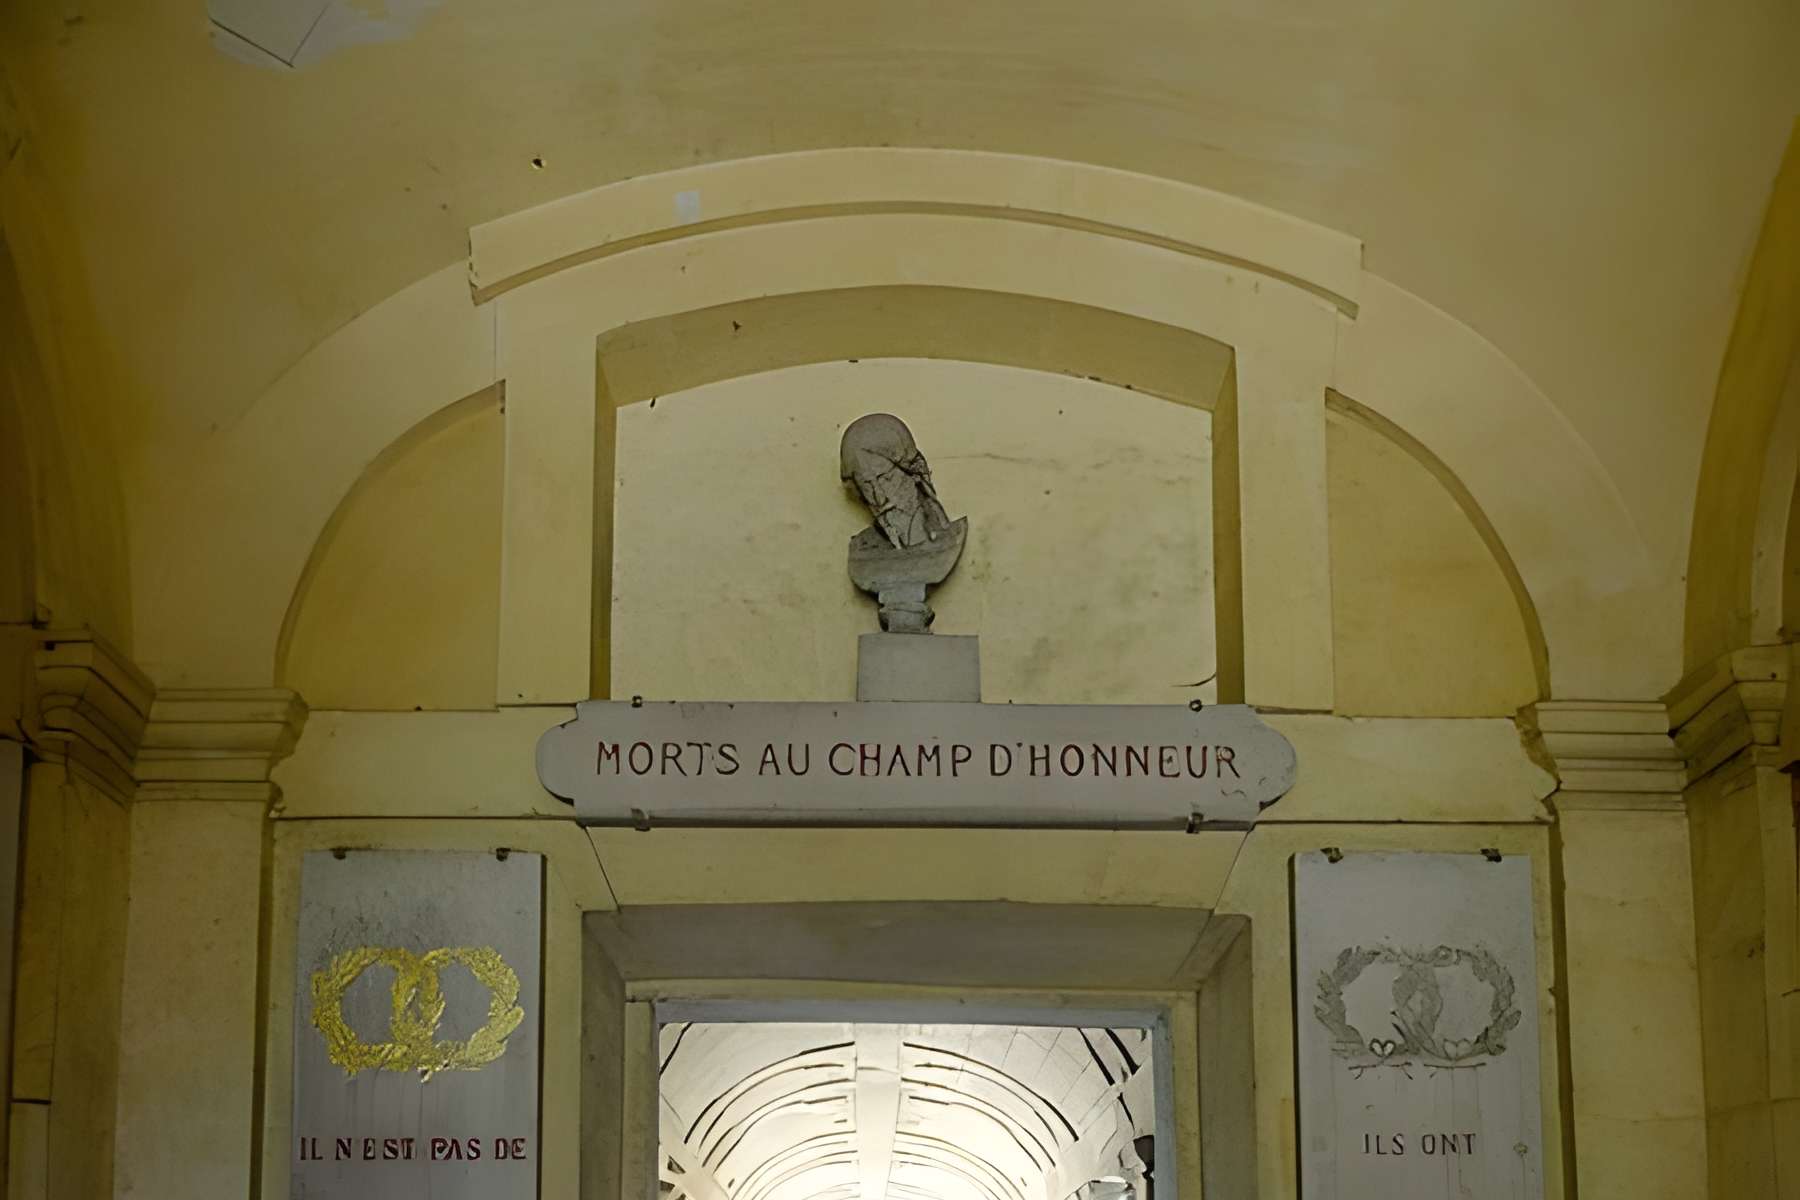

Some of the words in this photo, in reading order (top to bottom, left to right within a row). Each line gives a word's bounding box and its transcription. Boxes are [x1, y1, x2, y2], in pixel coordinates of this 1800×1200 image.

[597, 741, 740, 777] MORTS
[758, 743, 810, 777] AU
[828, 742, 972, 777] CHAMP
[989, 742, 1241, 779] D'HONNEUR
[300, 1137, 323, 1161] IL
[431, 1137, 481, 1161] PAS
[495, 1137, 527, 1161] DE
[1363, 1133, 1405, 1155] ILS
[1421, 1133, 1476, 1155] ONT
